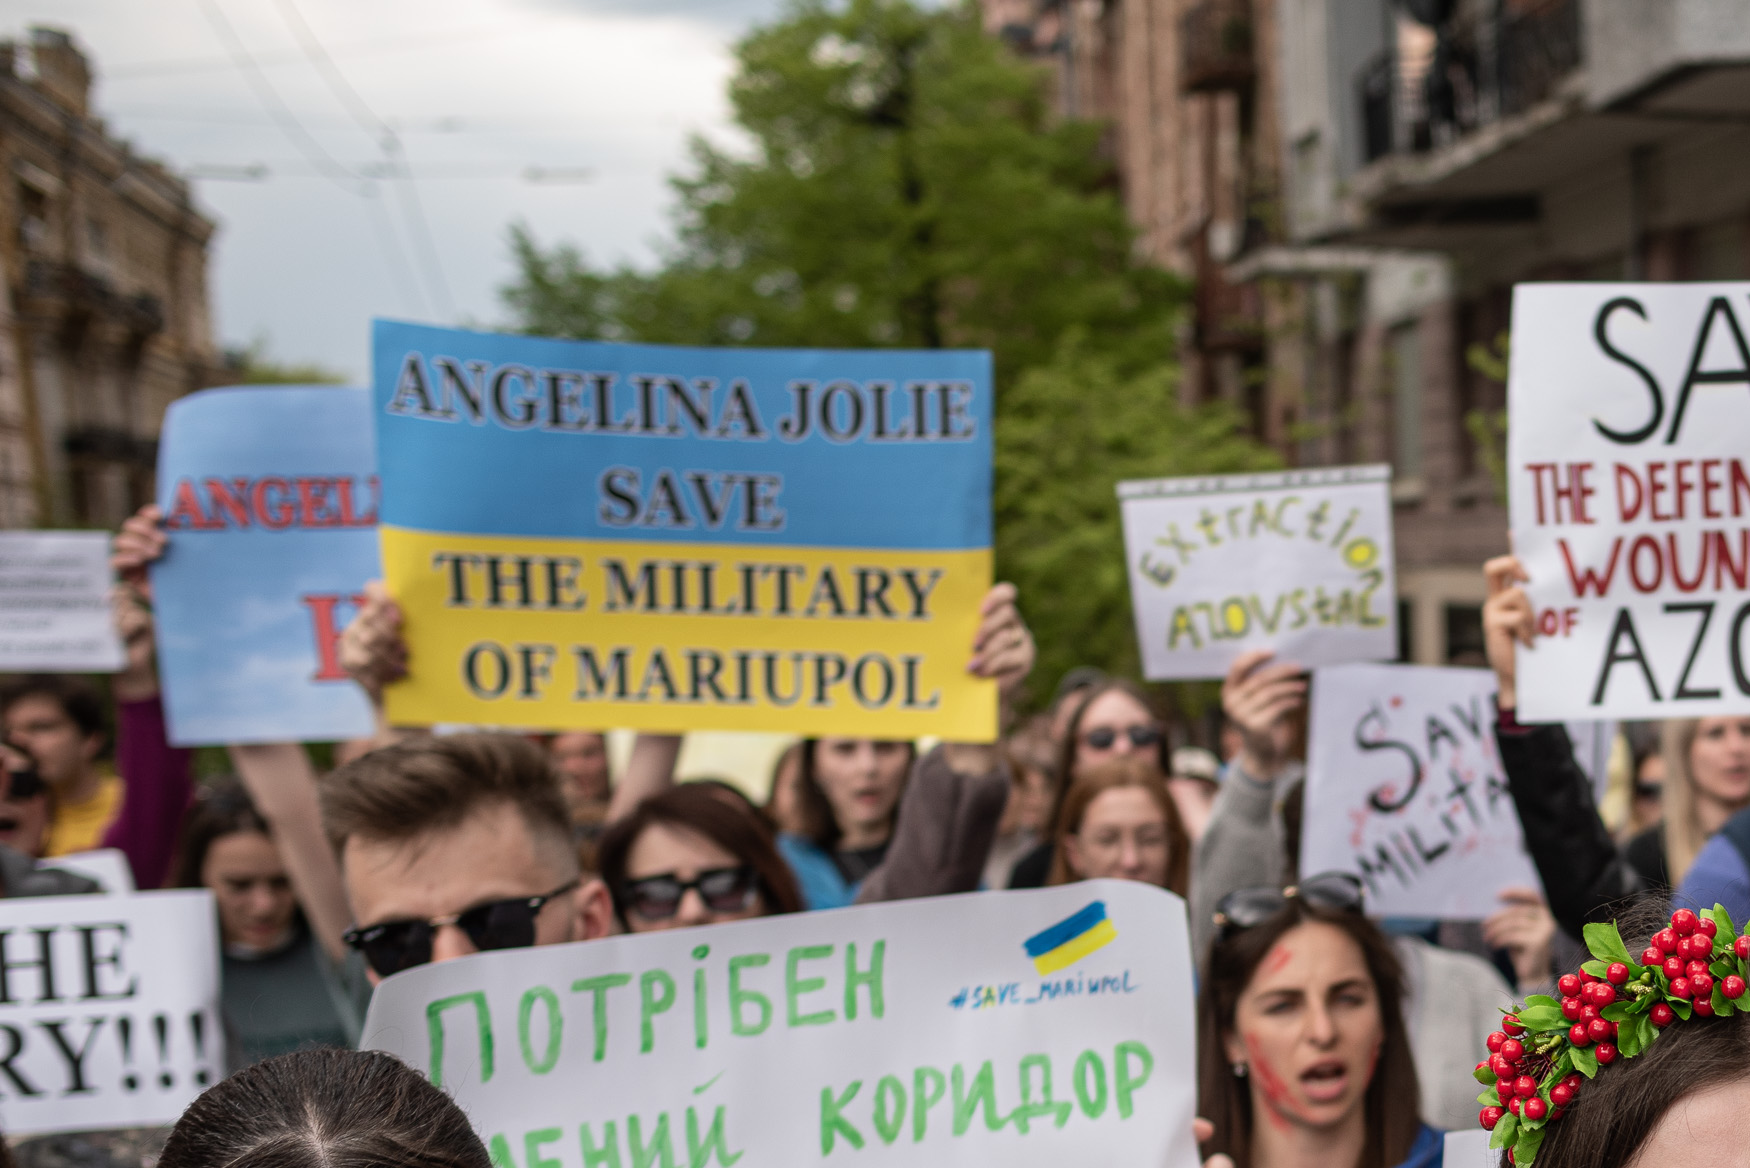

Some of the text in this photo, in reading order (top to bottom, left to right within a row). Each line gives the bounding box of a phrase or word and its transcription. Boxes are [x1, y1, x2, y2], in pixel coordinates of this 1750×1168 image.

[385, 350, 976, 443] ANGELINA JOLIE
[599, 465, 786, 532] SAVE
[1524, 462, 1596, 525] THE
[433, 551, 945, 620] THE MILITARY
[1537, 606, 1580, 639] OF
[462, 640, 942, 710] OF MARIUPOL
[1355, 693, 1498, 815] SAV
[819, 1041, 1155, 1157] КОРИДОР
